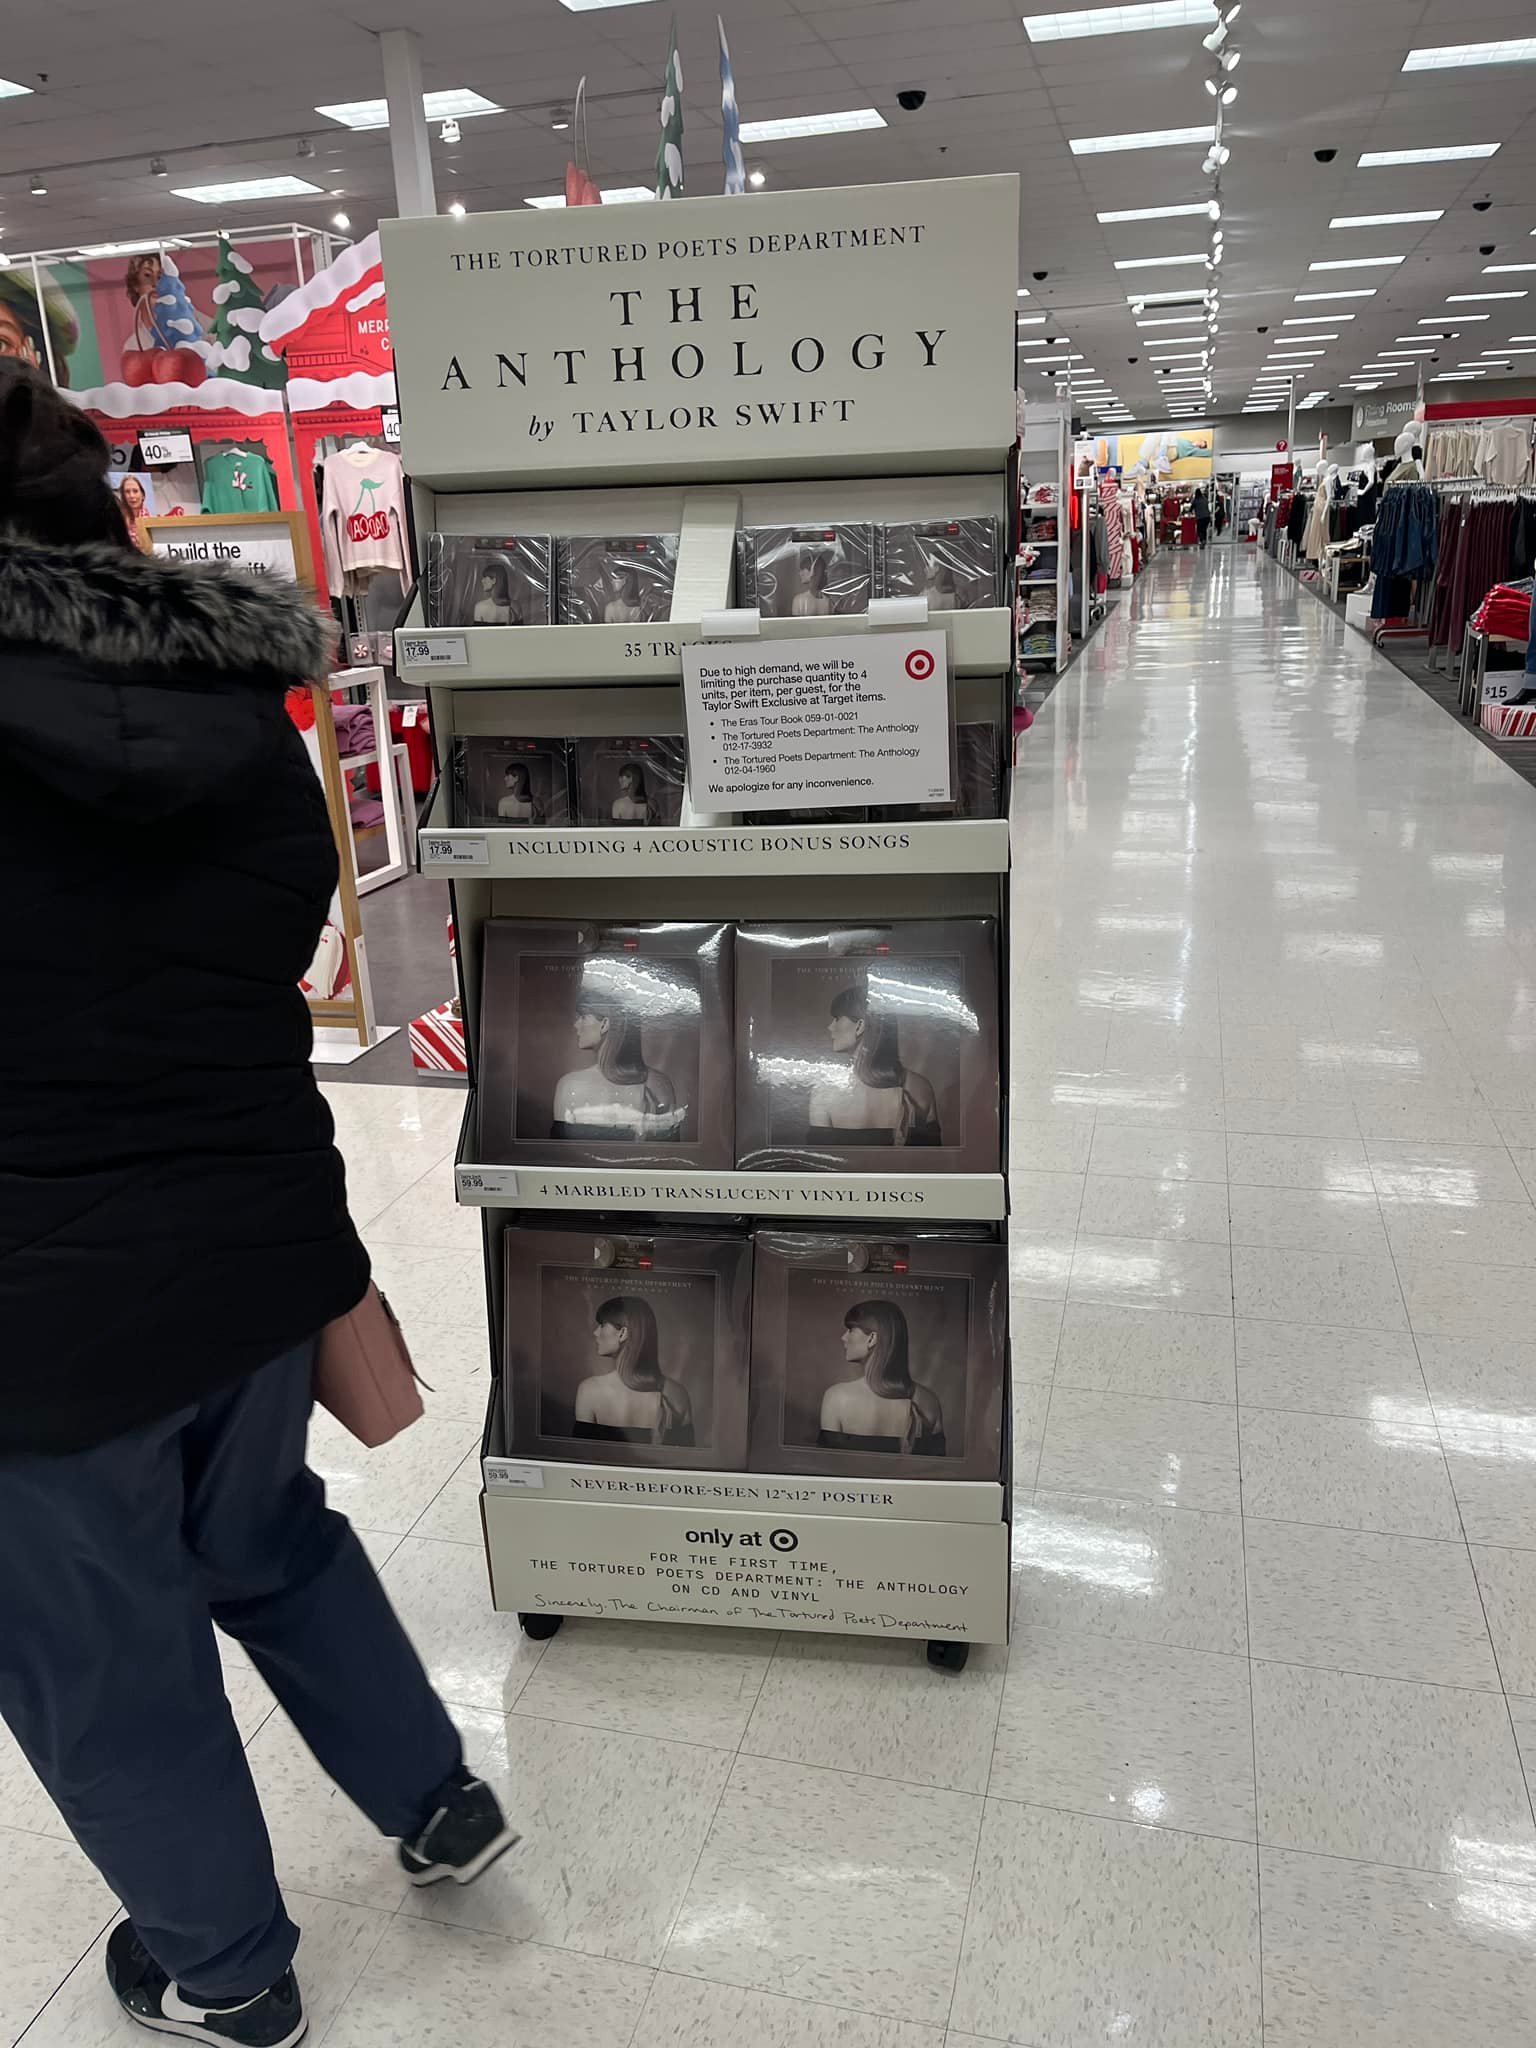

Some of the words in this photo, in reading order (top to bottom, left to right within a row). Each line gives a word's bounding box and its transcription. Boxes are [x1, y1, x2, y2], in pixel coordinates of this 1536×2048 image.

[451, 252, 501, 271] THE
[510, 243, 648, 269] TORTURED
[658, 237, 738, 261] POETS
[748, 225, 926, 255] DEPARTMENT
[610, 284, 760, 326] THE
[440, 329, 949, 391] ANTHOLOGY
[528, 414, 555, 442] by
[572, 406, 720, 436] TAYLOR
[736, 399, 858, 428] SWIFT
[167, 542, 209, 560] build
[213, 541, 241, 559] the
[405, 646, 430, 656] 17.99
[624, 643, 643, 657] 35
[700, 667, 720, 677] Due
[722, 667, 733, 676] to
[735, 666, 757, 677] high
[759, 662, 803, 674] demand,
[805, 663, 820, 671] we
[822, 660, 839, 670] will
[841, 660, 855, 669] be
[700, 678, 736, 689] limiting
[738, 676, 754, 686] the
[756, 675, 803, 687] purchase
[805, 672, 846, 684] quantity
[848, 671, 859, 680] to
[860, 670, 867, 679] 4
[701, 690, 729, 700] units,
[730, 689, 748, 699] per
[749, 687, 774, 697] item,
[776, 687, 793, 697] per
[795, 685, 826, 696] guest,
[829, 683, 843, 693] for
[845, 682, 861, 691] the
[1485, 686, 1508, 699] $15
[702, 701, 732, 712] Taylor
[734, 699, 760, 709] Swift
[761, 696, 808, 708] Exclusive
[810, 696, 820, 705] at
[822, 694, 854, 705] Target
[855, 693, 886, 702] items.
[721, 719, 737, 727] The
[739, 718, 758, 727] Eras
[760, 716, 779, 725] Tour
[780, 715, 803, 724] Book
[804, 711, 858, 723] 059-01-0021
[722, 732, 738, 741] The
[740, 731, 775, 740] Tortured
[777, 729, 801, 738] Poets
[803, 726, 856, 738] Department:
[857, 725, 874, 734] The
[876, 723, 920, 734] Anthology
[722, 741, 773, 751] 012-17-3932
[723, 756, 740, 765] The
[742, 754, 777, 764] Tortured
[779, 753, 803, 762] Poets
[804, 750, 857, 762] Department:
[859, 749, 875, 758] The
[877, 747, 920, 757] Anthology
[724, 764, 776, 775] 012-04-1960
[708, 784, 724, 793] We
[726, 782, 770, 793] apologize
[772, 781, 785, 790] for
[786, 781, 803, 791] any
[805, 777, 875, 789] inconvenience.
[429, 845, 453, 855] 17.99
[508, 840, 626, 855] INCLUDING
[632, 841, 643, 854] 4
[648, 838, 754, 853] ACOUSTIC
[761, 836, 833, 851] BONUS
[839, 834, 911, 849] SONGS
[540, 1184, 548, 1195] 4
[555, 1184, 646, 1198] MARBLED
[652, 1186, 794, 1201] TRANSLUCENT
[800, 1189, 860, 1202] VINYL
[866, 1190, 925, 1203] DISCS
[570, 1478, 759, 1498] NEVER-BEFORE-SEEN
[822, 1491, 894, 1505] POSTER
[685, 1528, 734, 1548] only
[739, 1531, 762, 1546] at
[650, 1552, 678, 1563] FOR
[688, 1554, 717, 1566] THE
[729, 1557, 778, 1569] FIRST
[789, 1560, 836, 1575] TIME,
[530, 1559, 558, 1570] THE
[568, 1562, 645, 1576] TORTURED
[656, 1567, 704, 1580] POETS
[715, 1571, 822, 1588] DEPARTMENT:
[836, 1578, 865, 1590] THE
[876, 1581, 969, 1596] ANTHOLOGY
[671, 1583, 691, 1594] ON
[701, 1586, 720, 1596] CD
[731, 1587, 760, 1598] AND
[771, 1590, 820, 1602] VINYL
[608, 1598, 639, 1611] The
[647, 1601, 719, 1616] Chairman
[726, 1607, 742, 1616] of
[747, 1607, 777, 1618] The
[878, 1613, 969, 1633] Department
